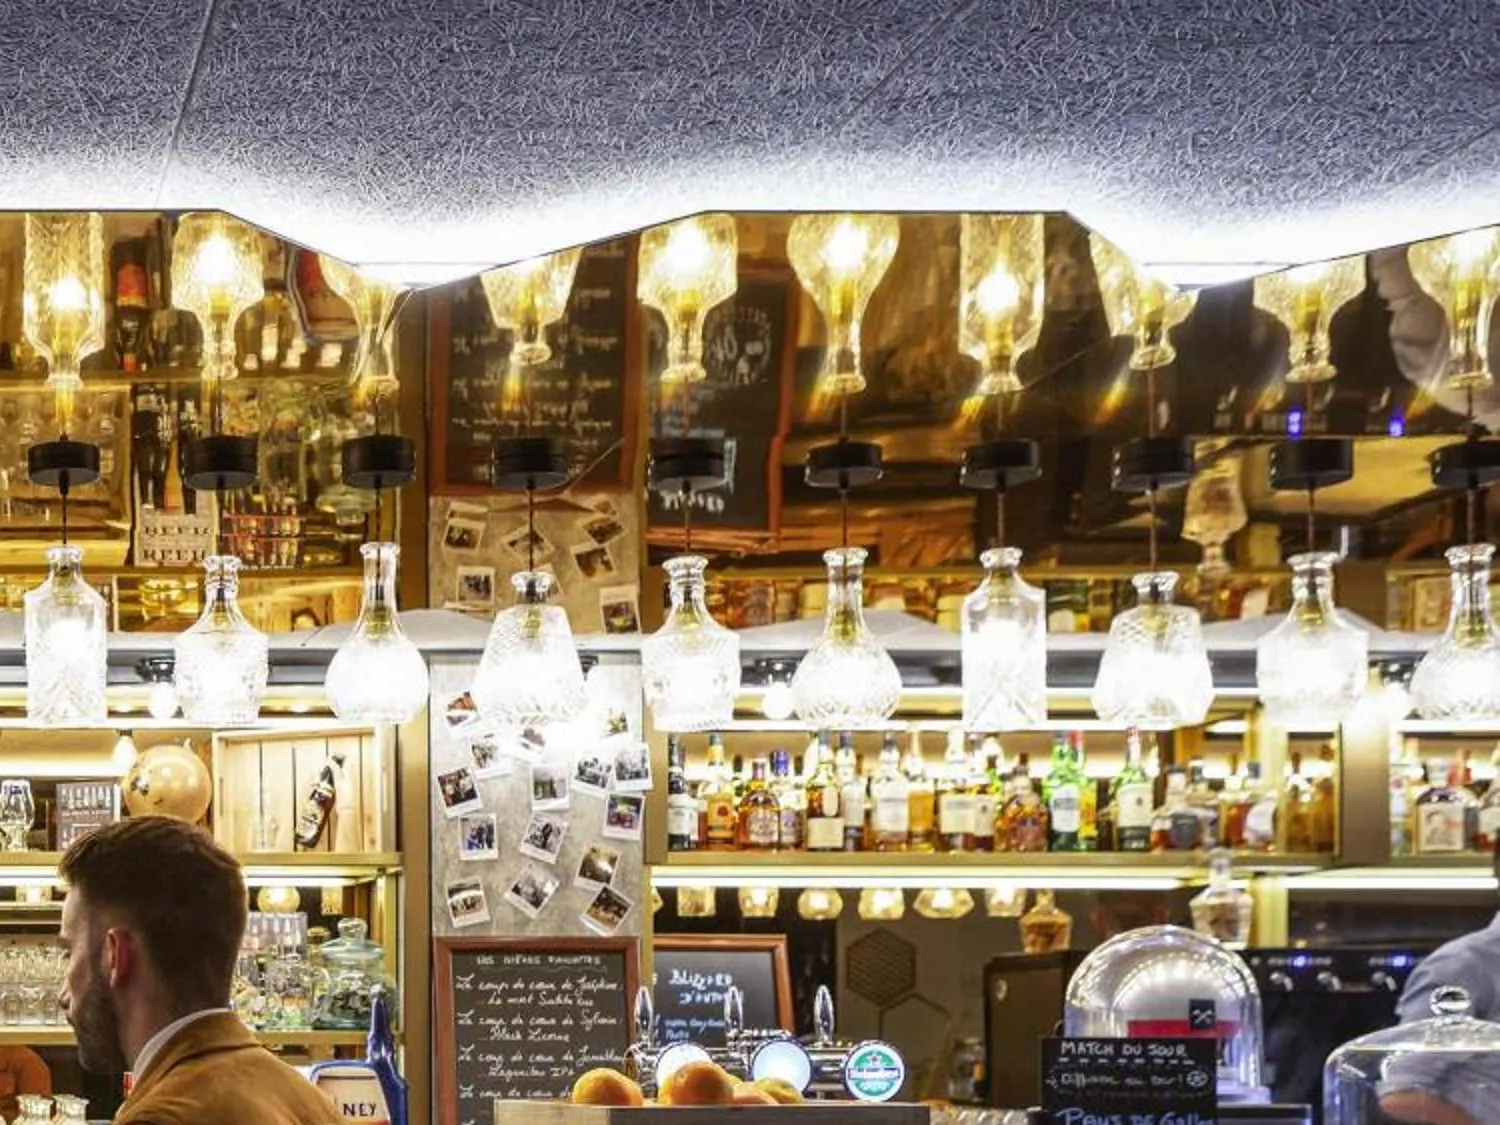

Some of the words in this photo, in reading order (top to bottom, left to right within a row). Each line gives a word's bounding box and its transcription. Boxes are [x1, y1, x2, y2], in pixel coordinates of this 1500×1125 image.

[1060, 1041, 1115, 1056] MATCH
[1121, 1043, 1142, 1056] DU
[1147, 1044, 1188, 1057] JOUR
[342, 1103, 378, 1117] NEY
